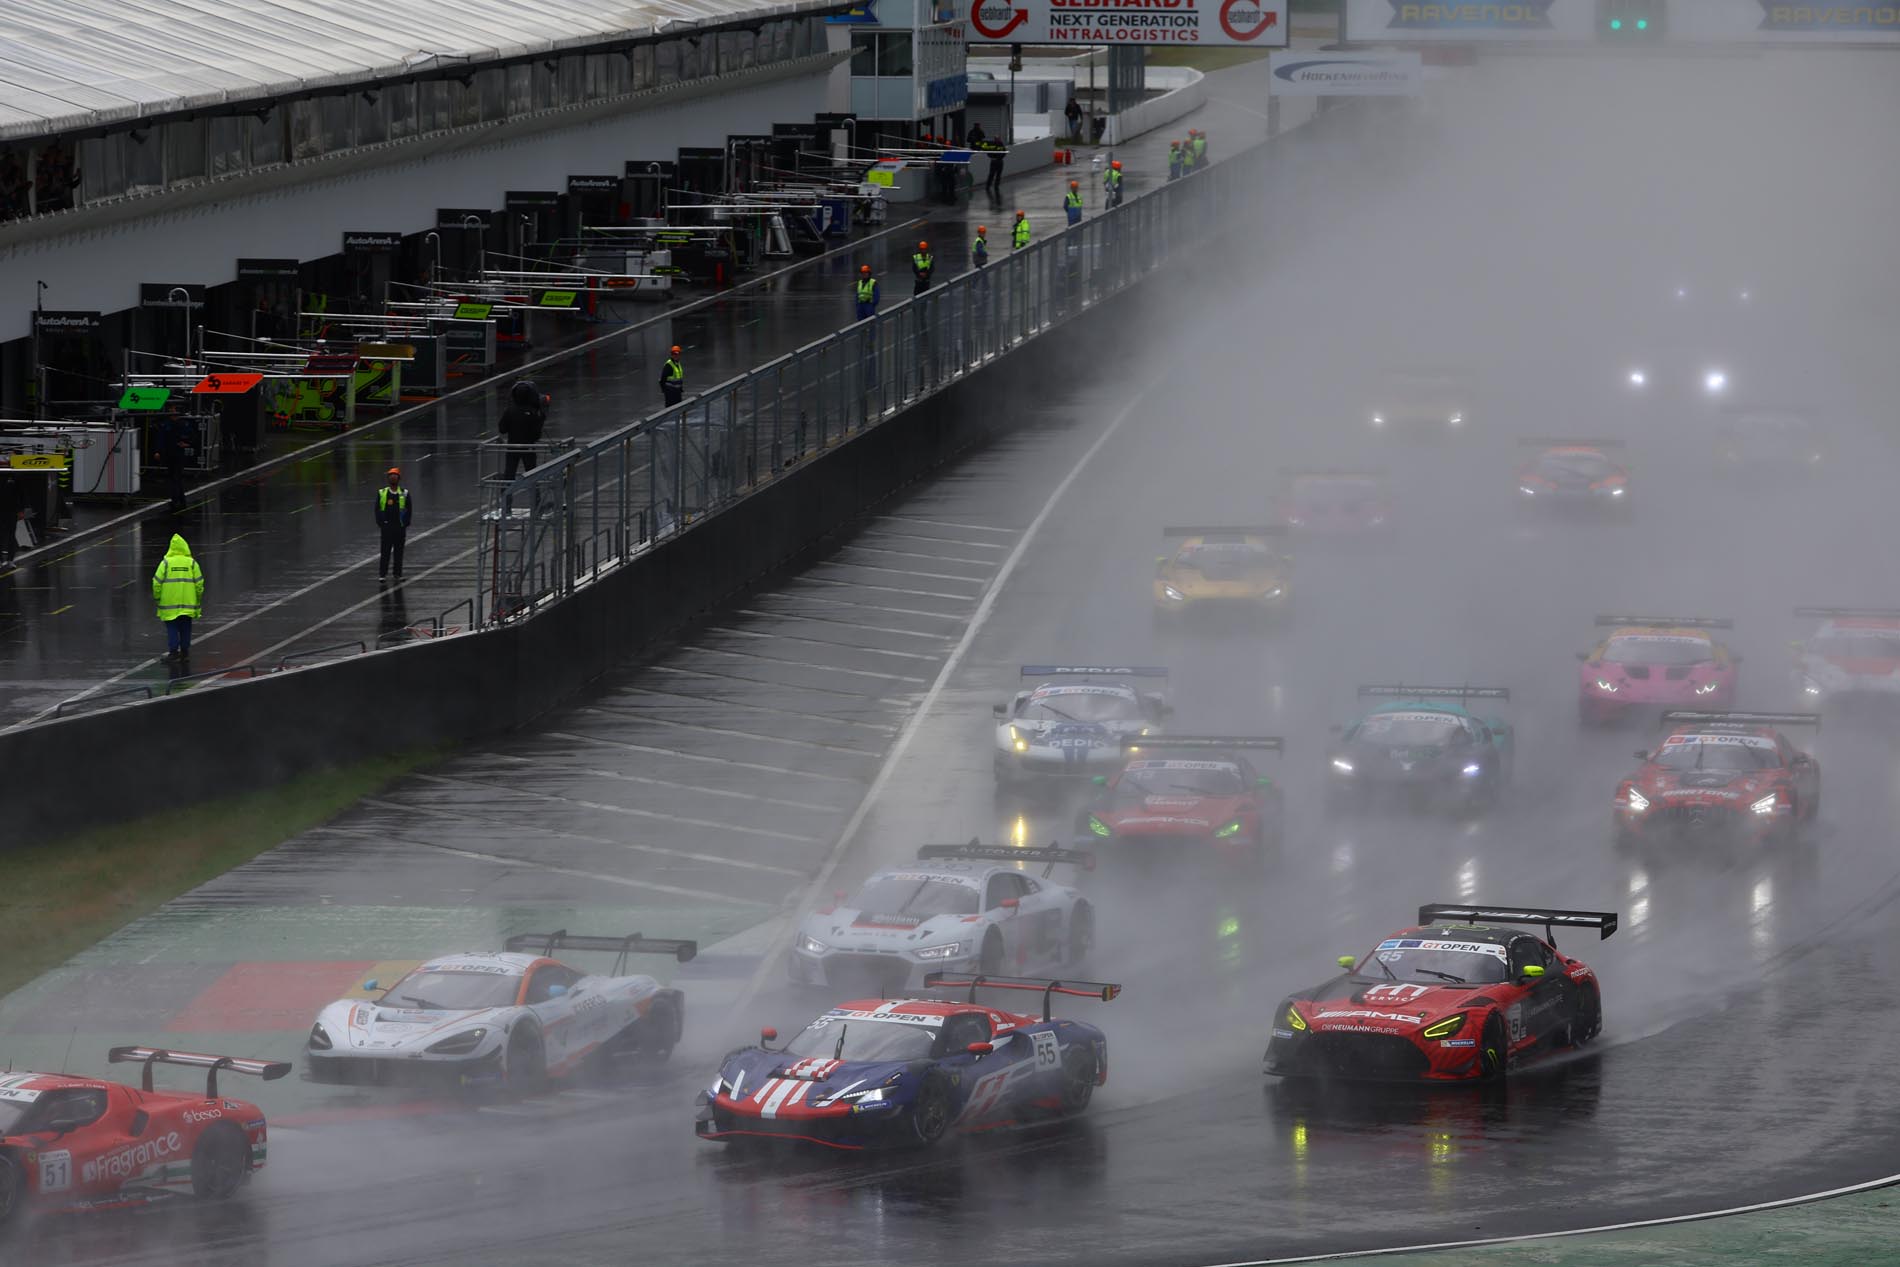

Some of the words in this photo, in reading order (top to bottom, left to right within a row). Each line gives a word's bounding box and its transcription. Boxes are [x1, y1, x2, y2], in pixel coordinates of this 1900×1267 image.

[1050, 14, 1093, 26] NEXT
[1098, 14, 1198, 26] GENERATION
[1401, 4, 1537, 22] RAVENOL
[1050, 28, 1199, 41] INTRALOGISTICS
[1037, 1042, 1056, 1066] 55
[96, 1131, 182, 1182] Fragrance
[45, 1161, 67, 1187] 51
